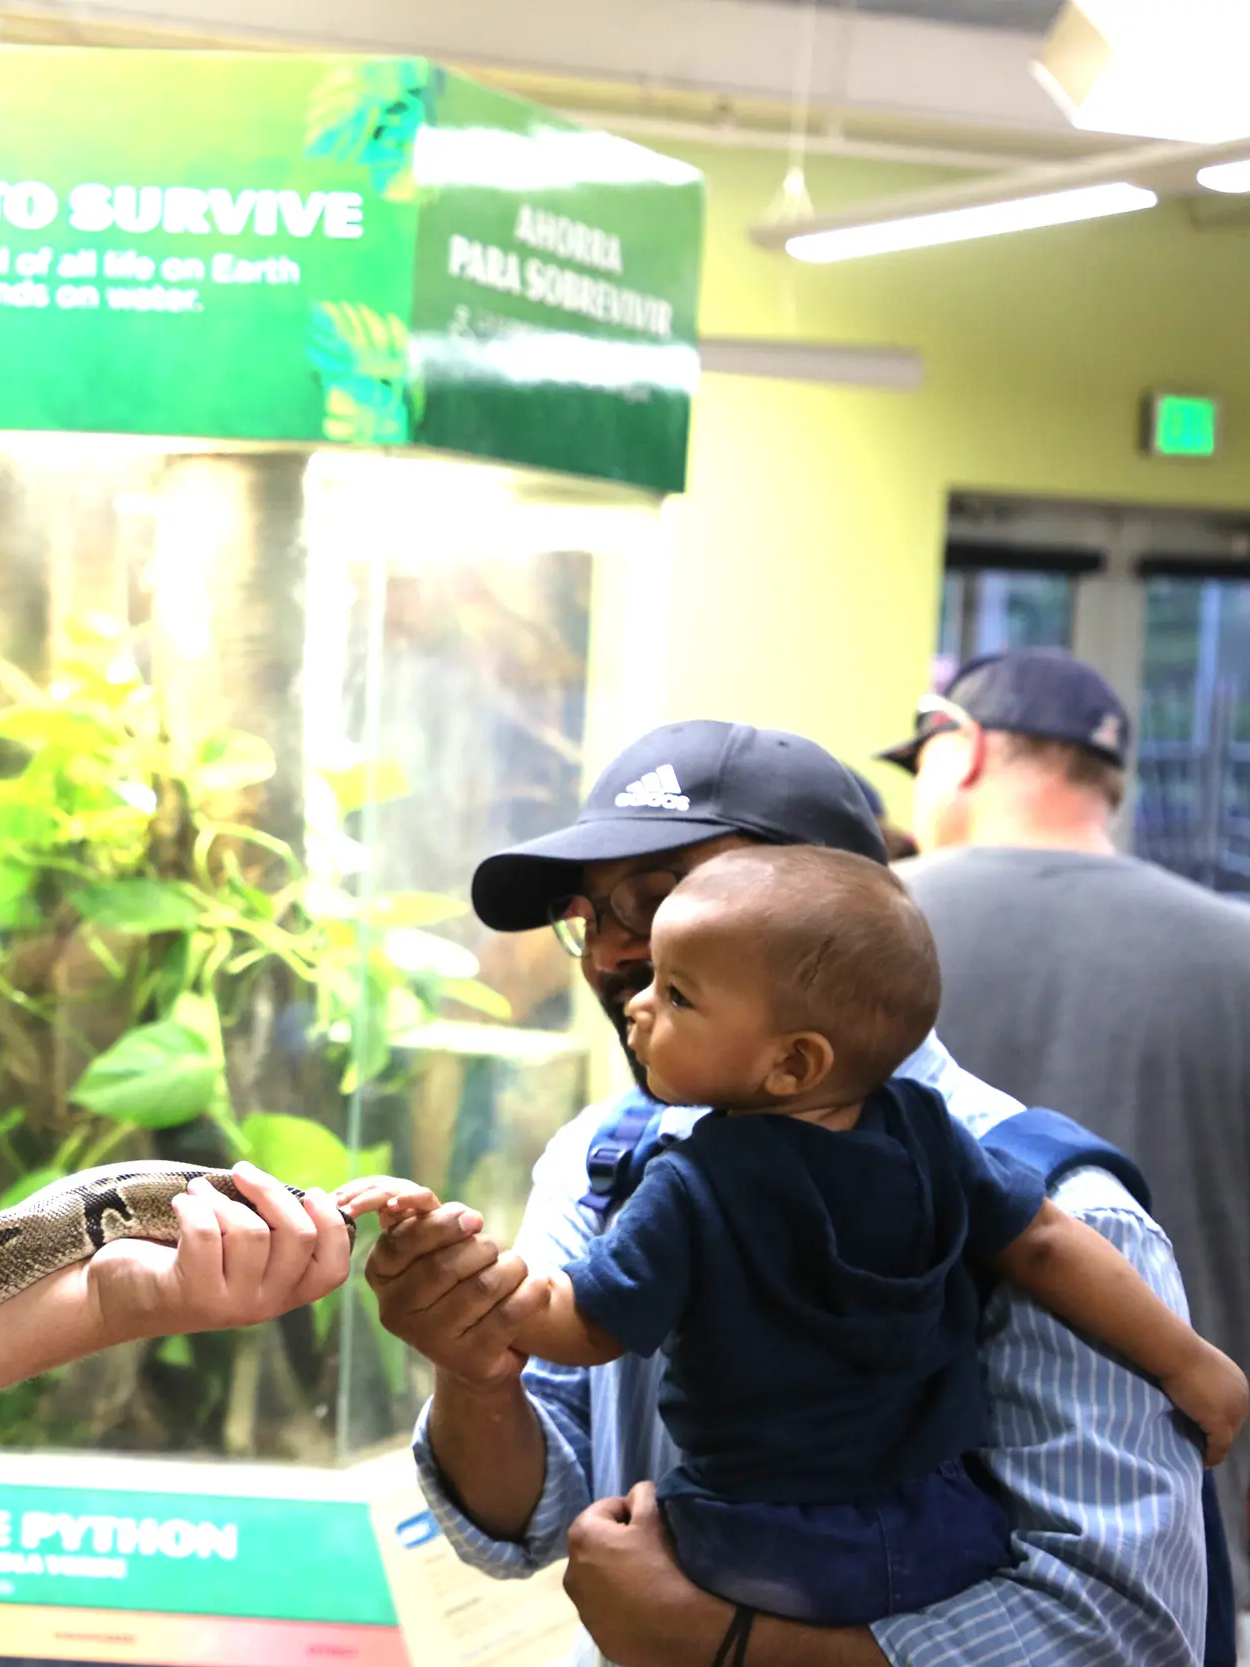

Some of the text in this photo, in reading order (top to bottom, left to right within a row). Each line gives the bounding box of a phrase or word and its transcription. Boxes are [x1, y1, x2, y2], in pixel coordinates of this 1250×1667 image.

[70, 183, 363, 238] SURVIVE
[514, 203, 623, 276] AHORRA
[16, 248, 51, 276] of
[58, 250, 96, 277] all
[104, 251, 155, 280] life
[162, 258, 205, 281] on
[212, 253, 300, 283] Earth
[448, 233, 675, 341] PARA SOBREVIVIR
[56, 285, 99, 308] on
[21, 1512, 237, 1559] PYTHON
